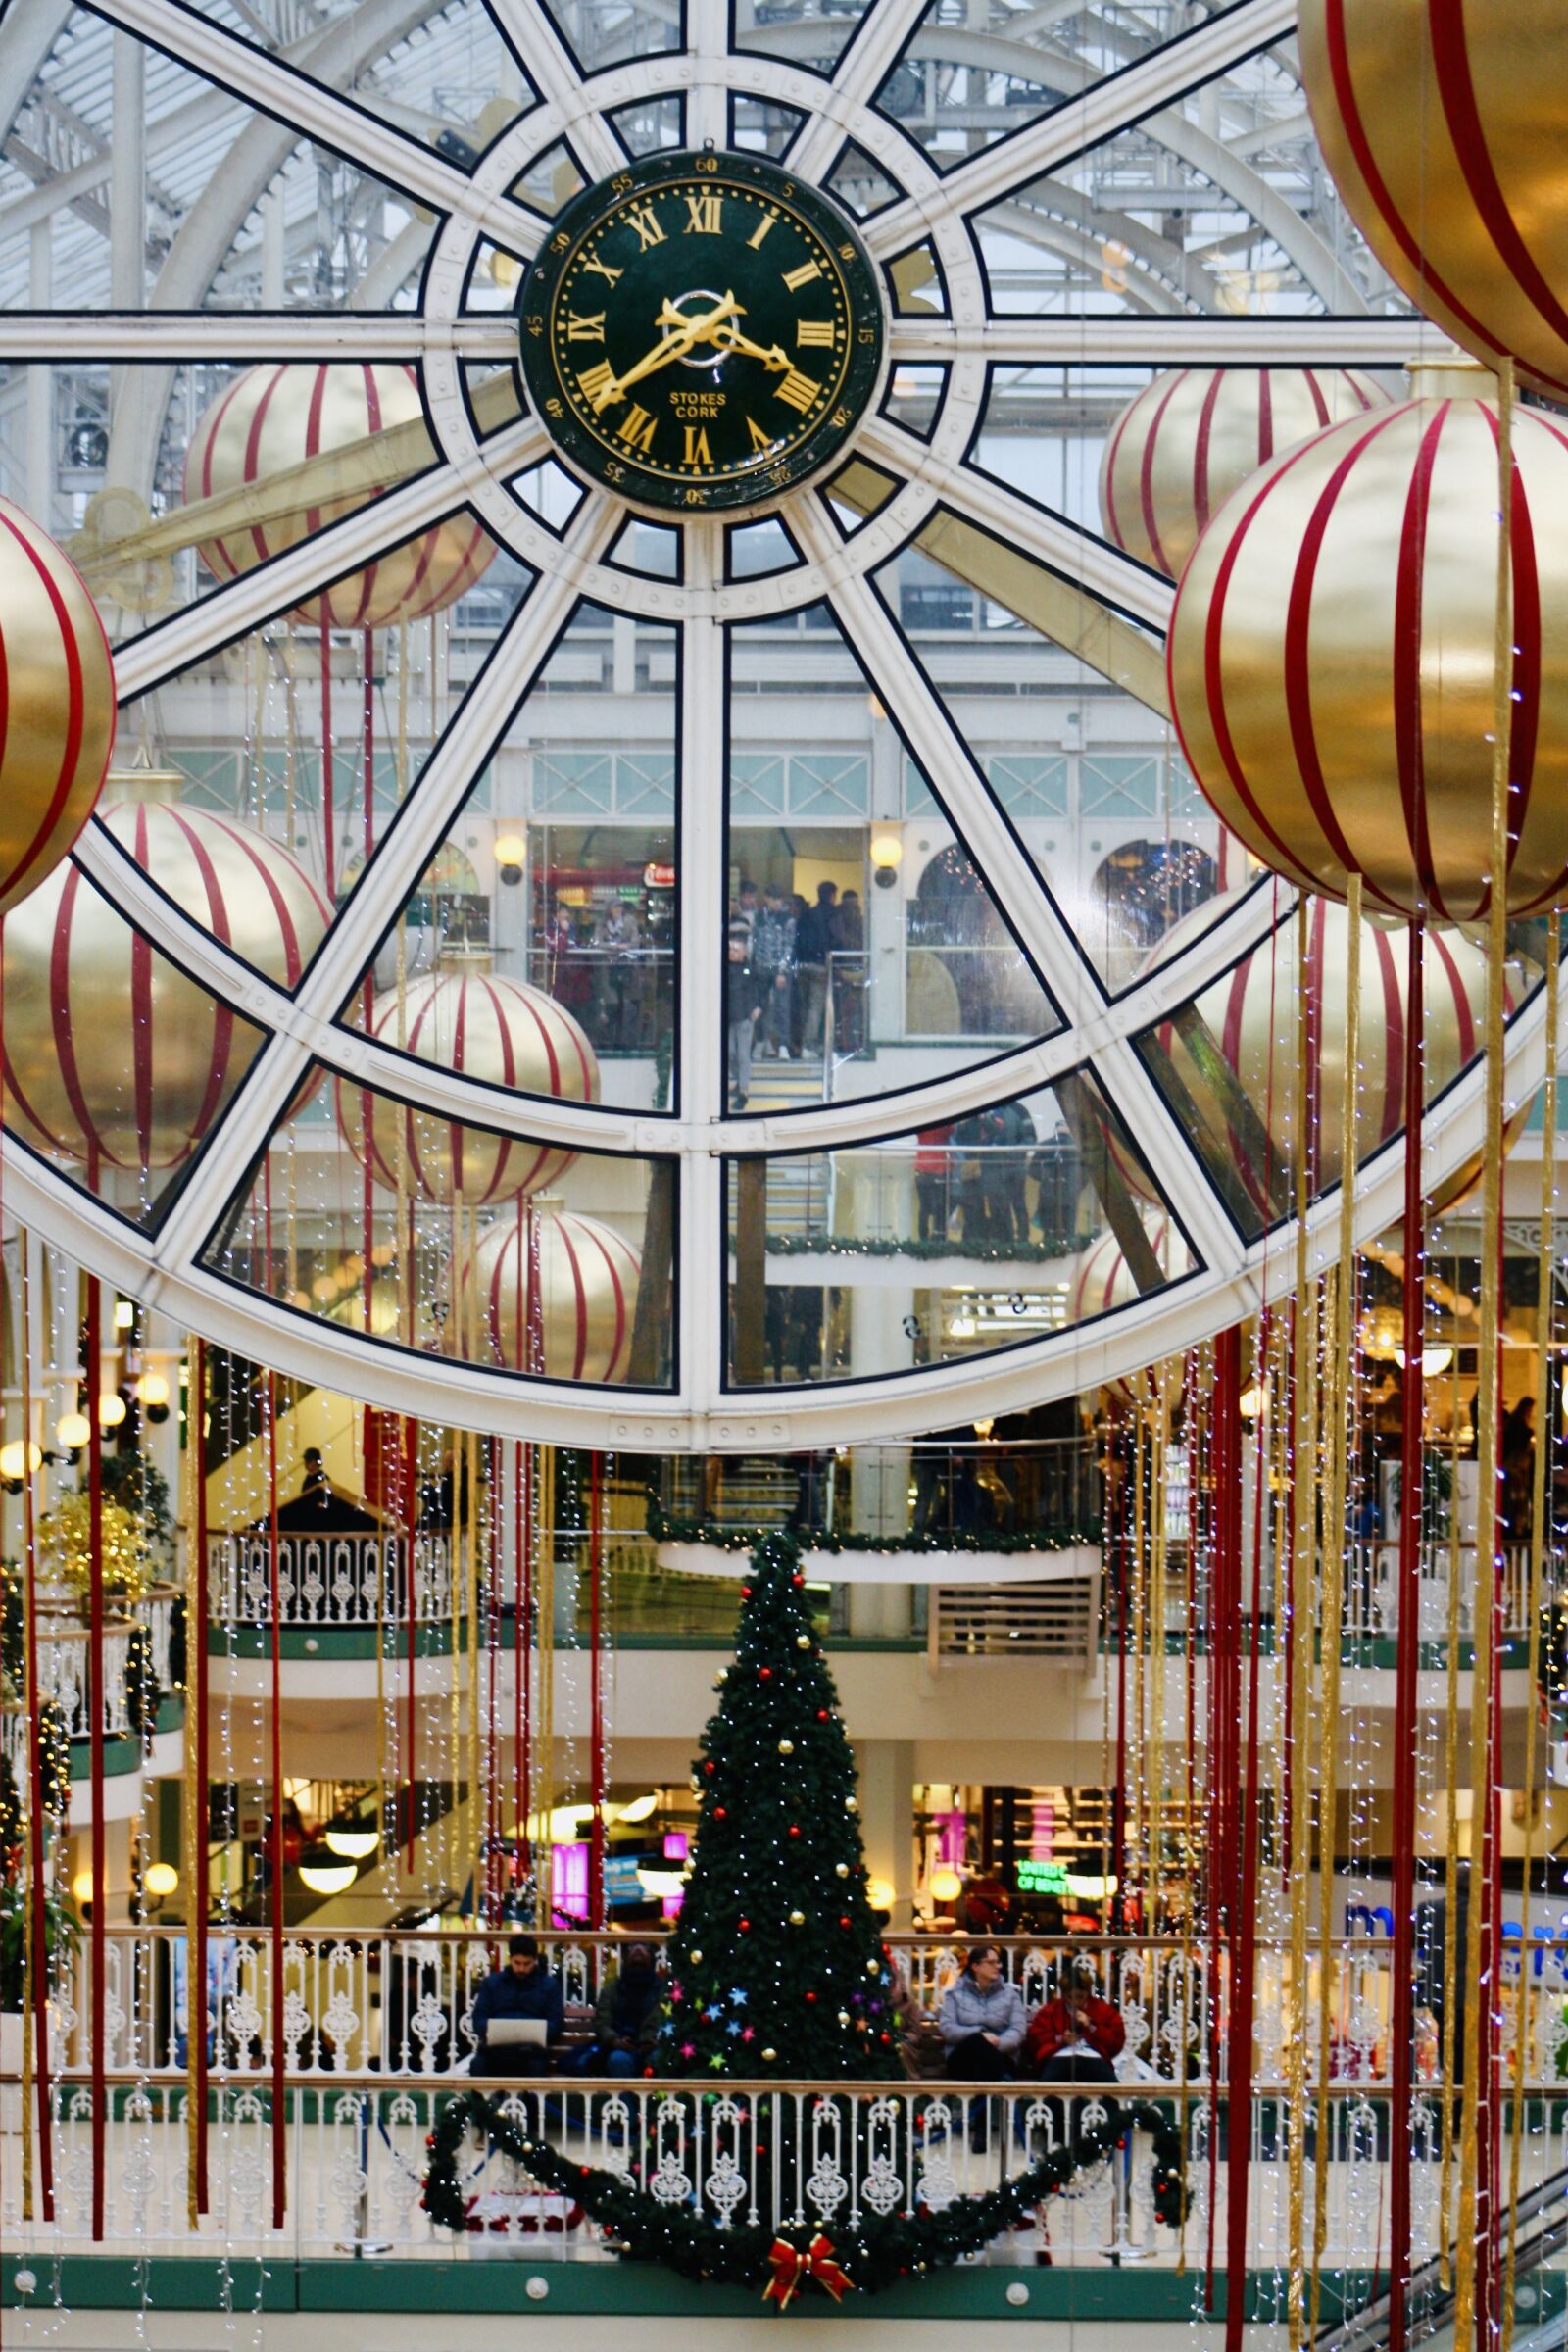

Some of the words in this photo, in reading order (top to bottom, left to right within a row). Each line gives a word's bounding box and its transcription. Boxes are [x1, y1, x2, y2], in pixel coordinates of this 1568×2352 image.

[695, 158, 718, 172] 60
[612, 173, 634, 194] 55
[782, 182, 795, 198] 5
[683, 196, 724, 235] XII
[624, 206, 668, 253] XI
[746, 212, 777, 251] I
[551, 233, 571, 256] 50
[583, 252, 625, 289] X
[781, 258, 823, 293] II
[528, 316, 543, 338] 45
[568, 310, 606, 343] IX
[797, 318, 835, 349] III
[858, 328, 874, 344] 15
[576, 358, 620, 416] III
[669, 391, 727, 406] STOKES
[774, 371, 822, 415] IIII
[545, 399, 564, 418] 40
[675, 406, 719, 418] CORK
[832, 407, 853, 428] 20
[615, 403, 660, 454] VII
[746, 416, 774, 453] V
[683, 426, 714, 465] VI
[1017, 1859, 1059, 1879] UNITED
[1017, 1875, 1035, 1890] OF
